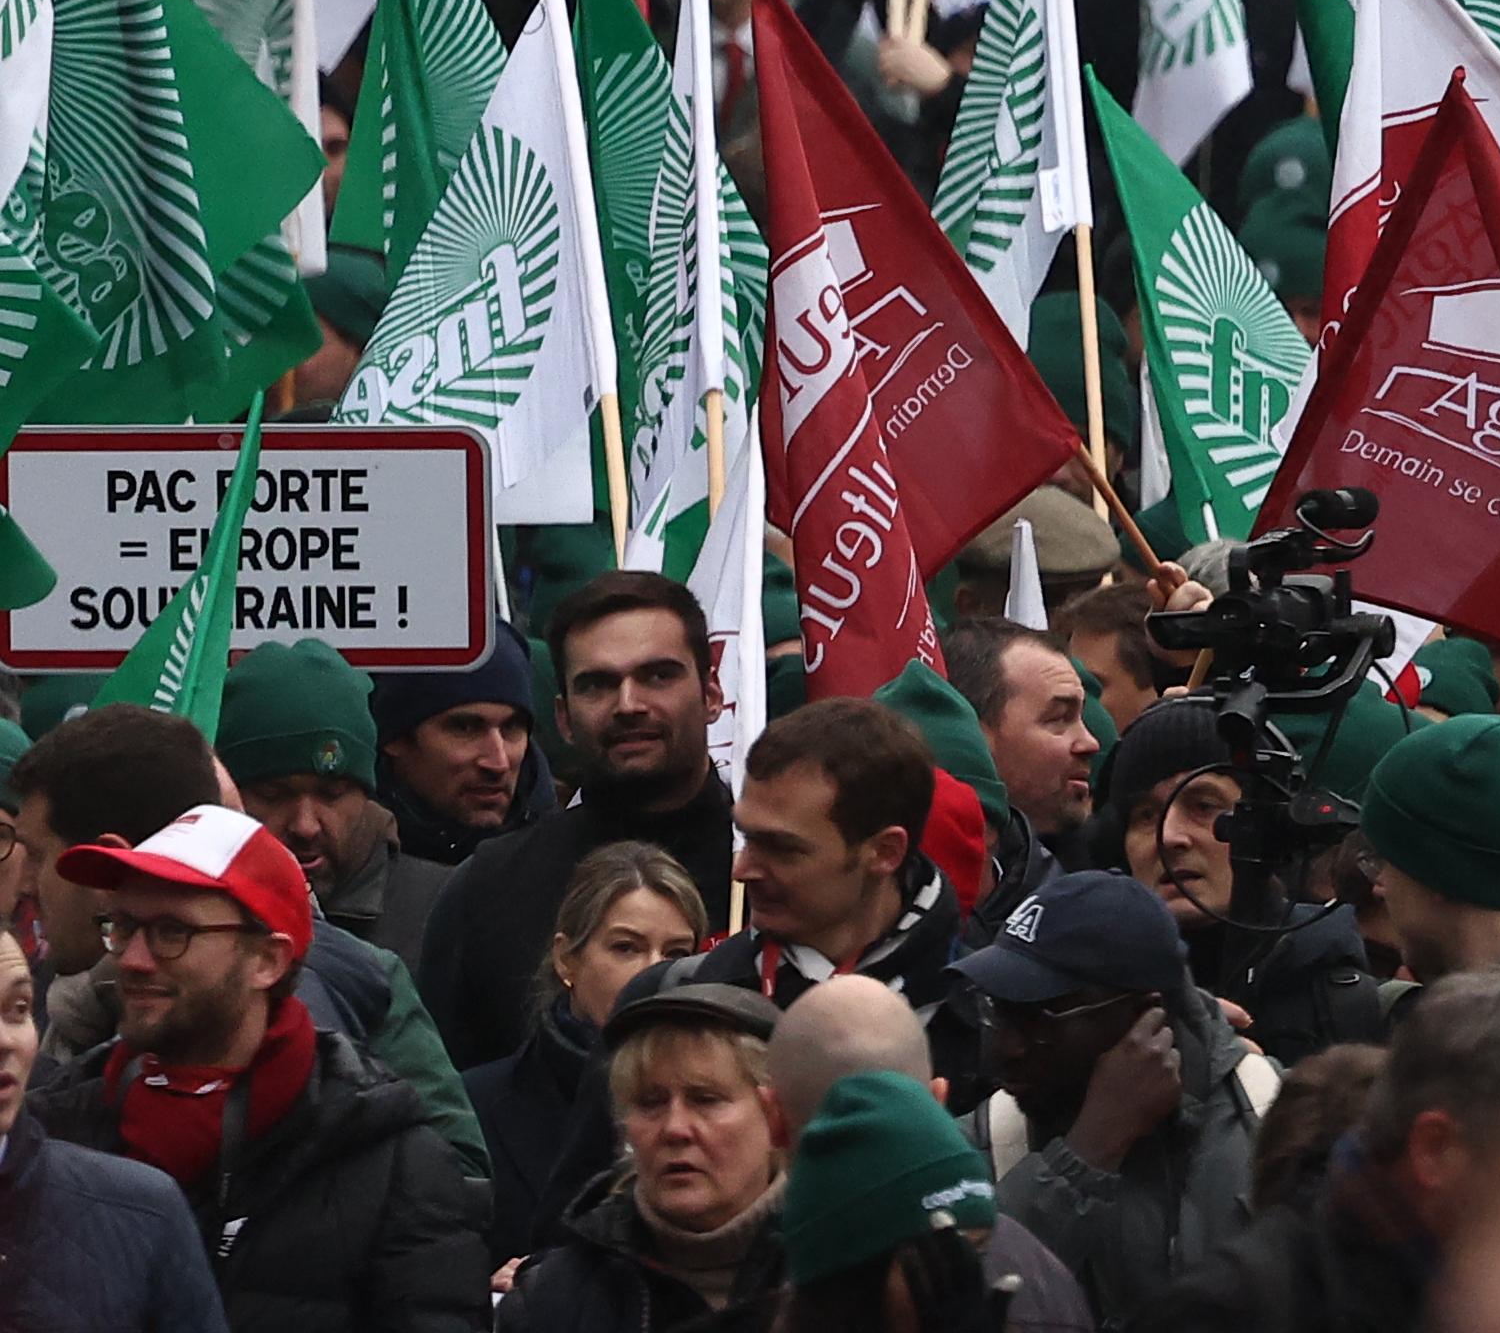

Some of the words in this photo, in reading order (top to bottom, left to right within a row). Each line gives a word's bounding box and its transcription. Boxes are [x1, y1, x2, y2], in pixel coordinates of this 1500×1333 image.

[1339, 428, 1445, 489] Demain
[1448, 476, 1483, 505] se
[107, 469, 197, 513] PAC
[169, 527, 361, 572] EROPE
[69, 585, 377, 631] SOURAINE
[397, 585, 410, 630] !
